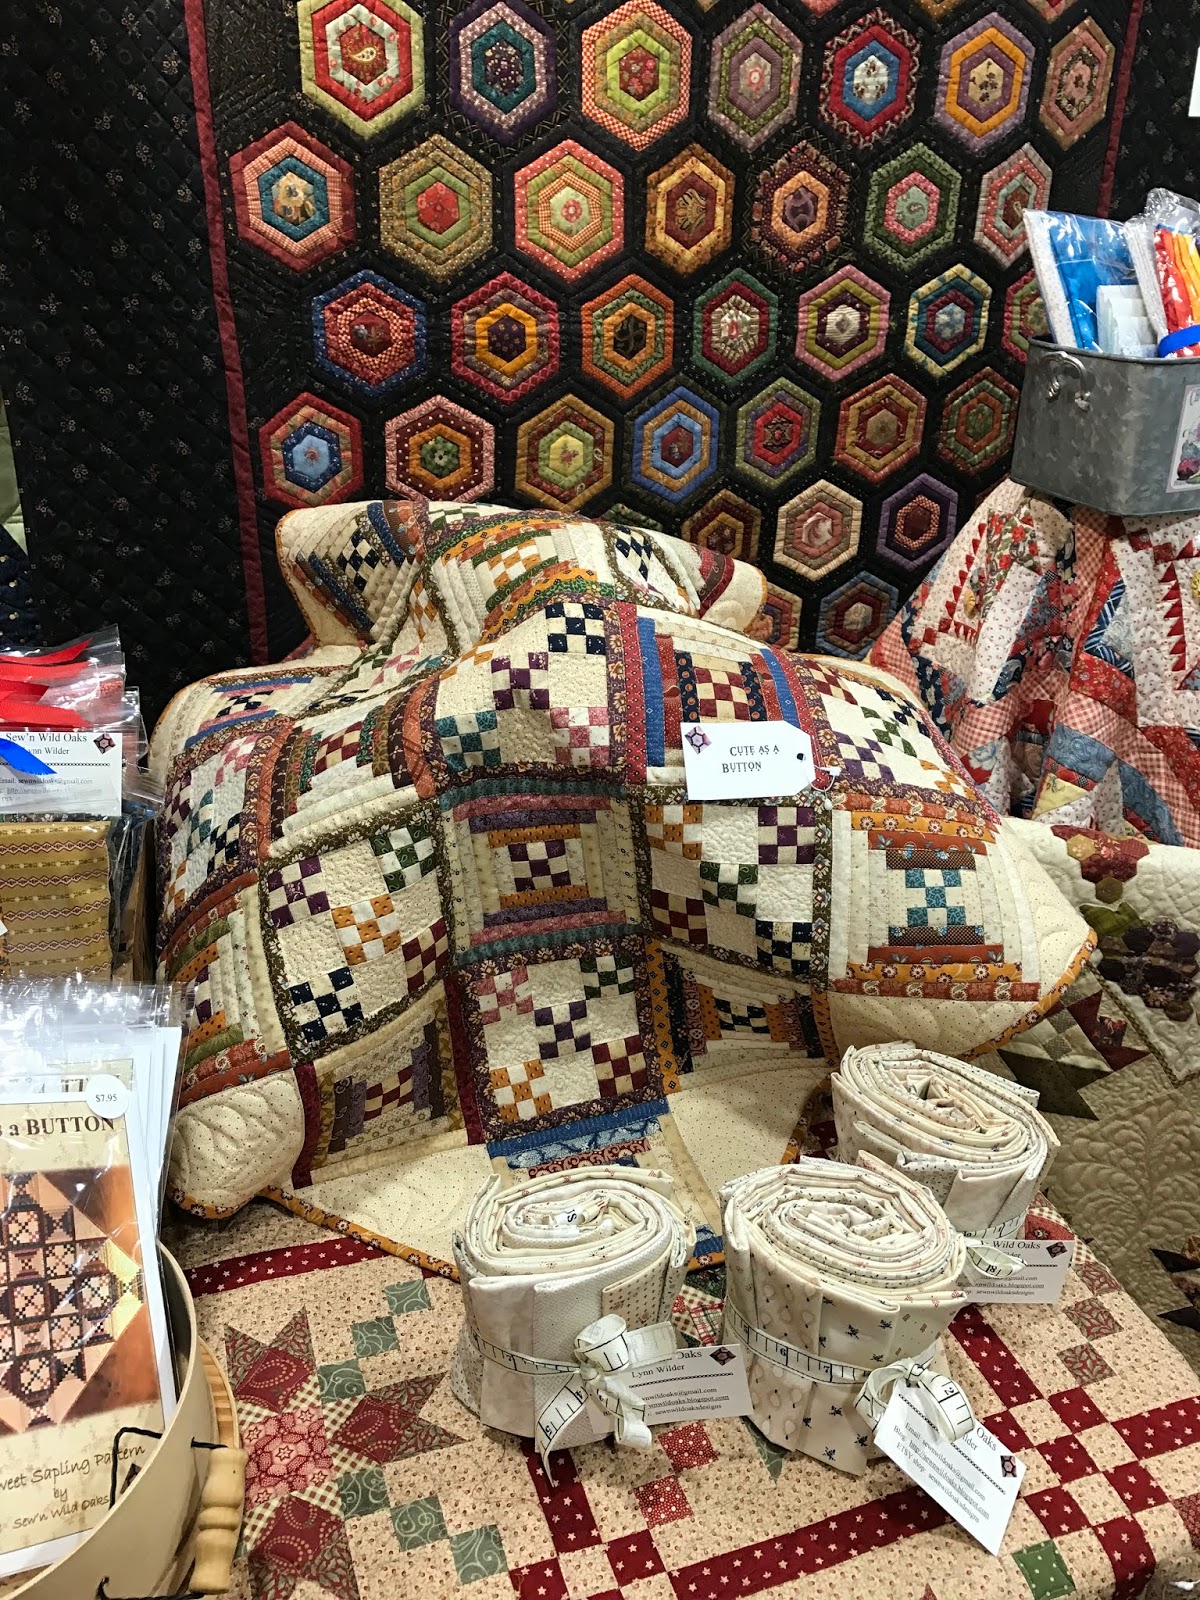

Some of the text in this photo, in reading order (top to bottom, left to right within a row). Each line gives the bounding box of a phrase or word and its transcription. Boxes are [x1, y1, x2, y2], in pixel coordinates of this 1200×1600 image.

[39, 732, 60, 742] Wild
[64, 732, 88, 742] Oaks
[44, 747, 70, 755] Wilder
[730, 744, 780, 756] CUTE AS A
[722, 762, 762, 773] BUTTON
[96, 1094, 118, 1102] $7.95
[9, 1124, 20, 1136] a
[26, 1116, 114, 1136] BUTTON
[993, 1240, 1041, 1250] Wild Oaks
[780, 1348, 786, 1356] 6
[632, 1364, 685, 1378] Lynn Wilder
[905, 1422, 923, 1440] Email:
[976, 1426, 998, 1452] Oaks
[896, 1441, 914, 1460] ETSY
[31, 1459, 91, 1484] Sapling
[94, 1446, 146, 1466] Patern
[53, 1486, 68, 1502] by
[12, 1494, 110, 1530] Sew'n Wild Oaks
